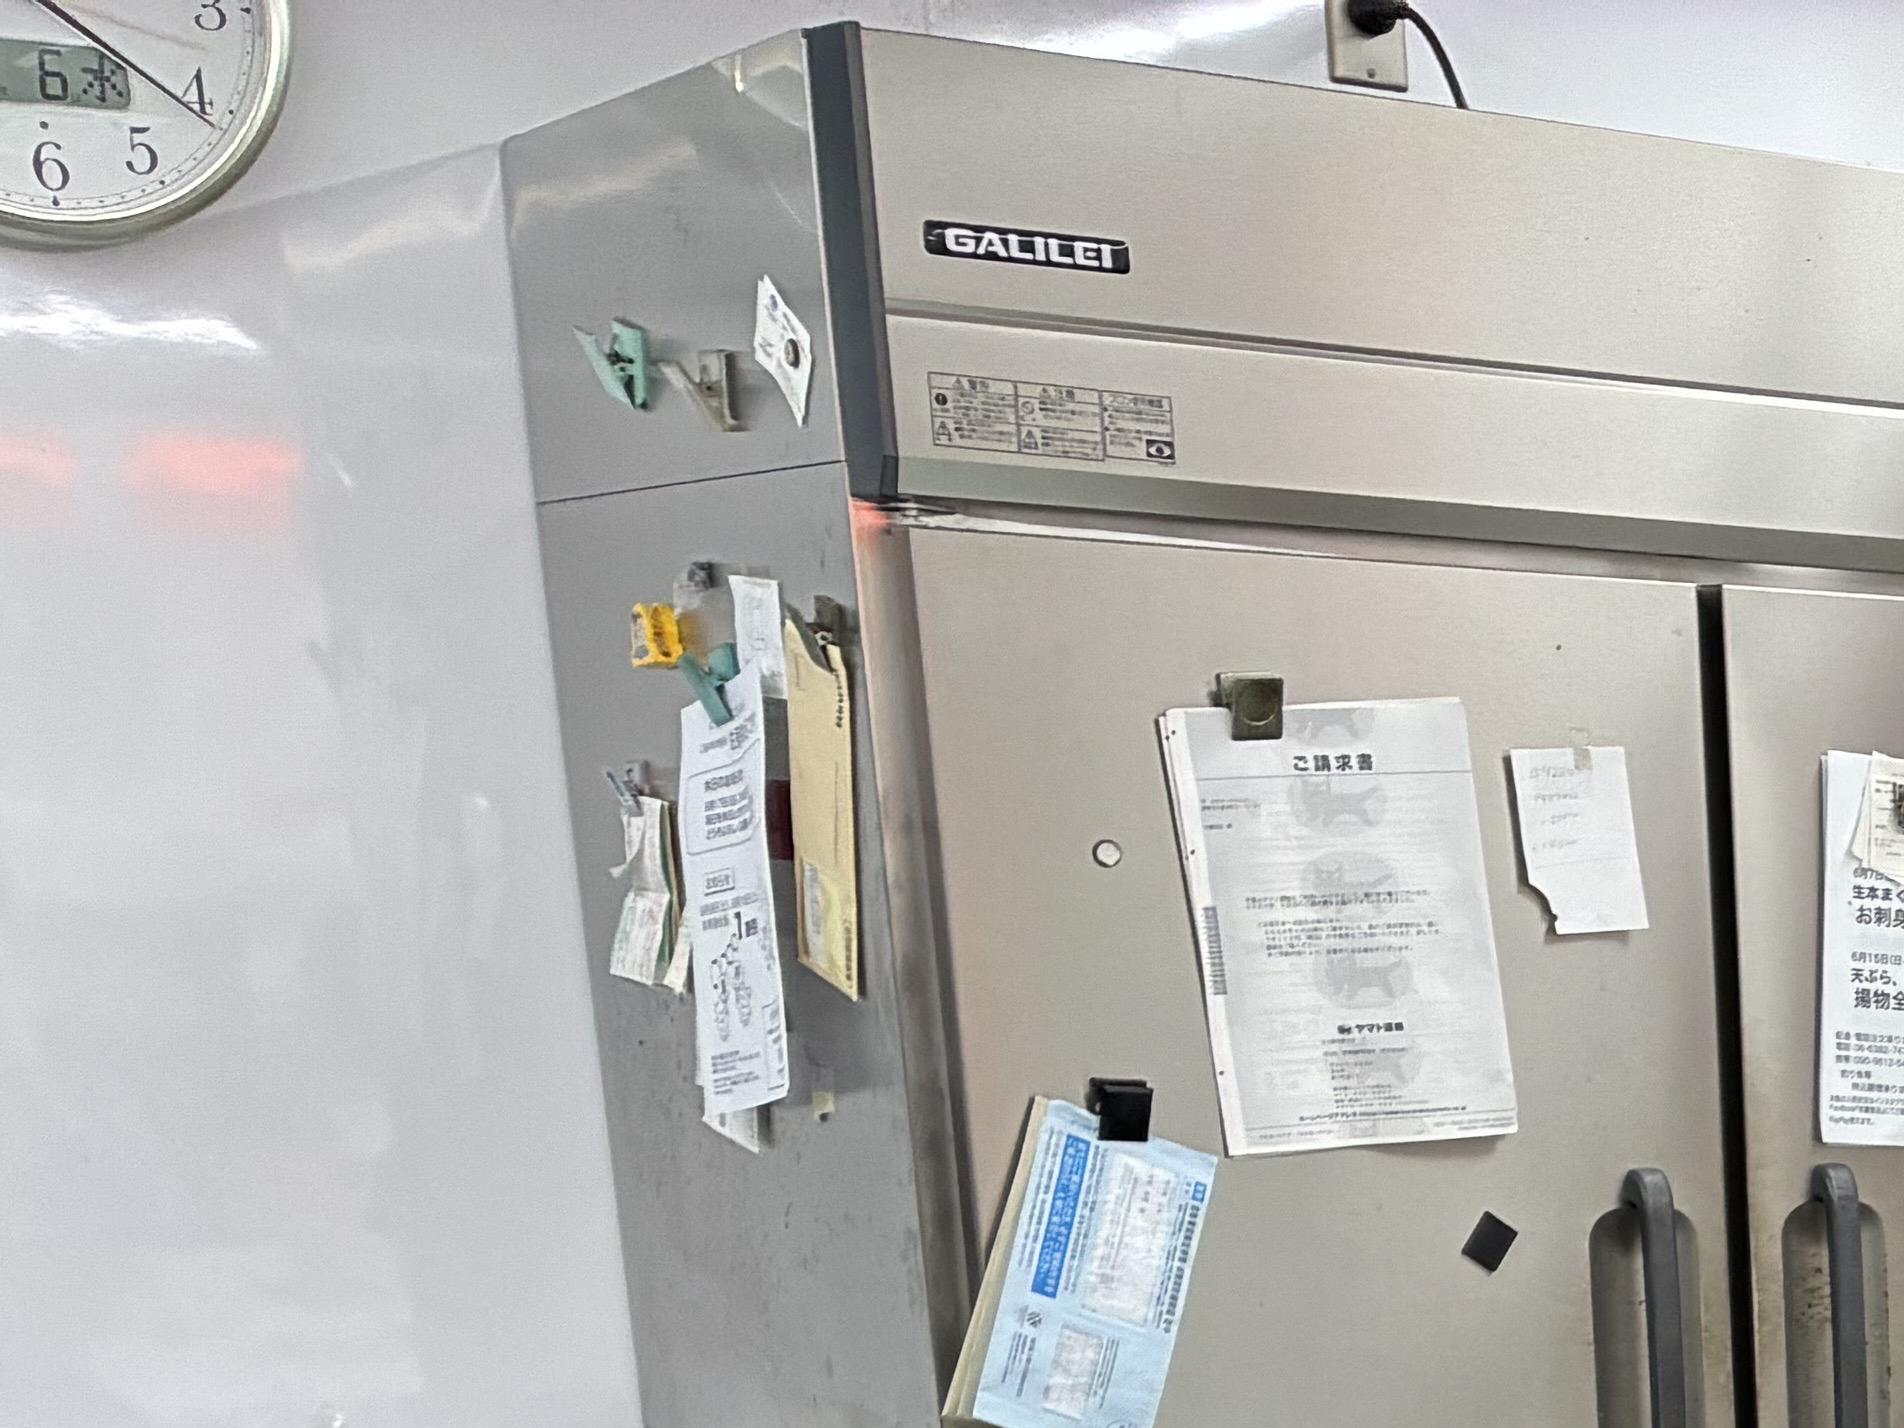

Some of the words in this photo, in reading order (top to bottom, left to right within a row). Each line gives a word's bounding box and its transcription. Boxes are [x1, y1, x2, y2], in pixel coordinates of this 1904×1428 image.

[180, 66, 214, 116] 4
[32, 141, 70, 191] 6
[125, 126, 159, 176] 5
[944, 227, 1114, 269] GALILEI
[1293, 752, 1374, 772] ご請求書
